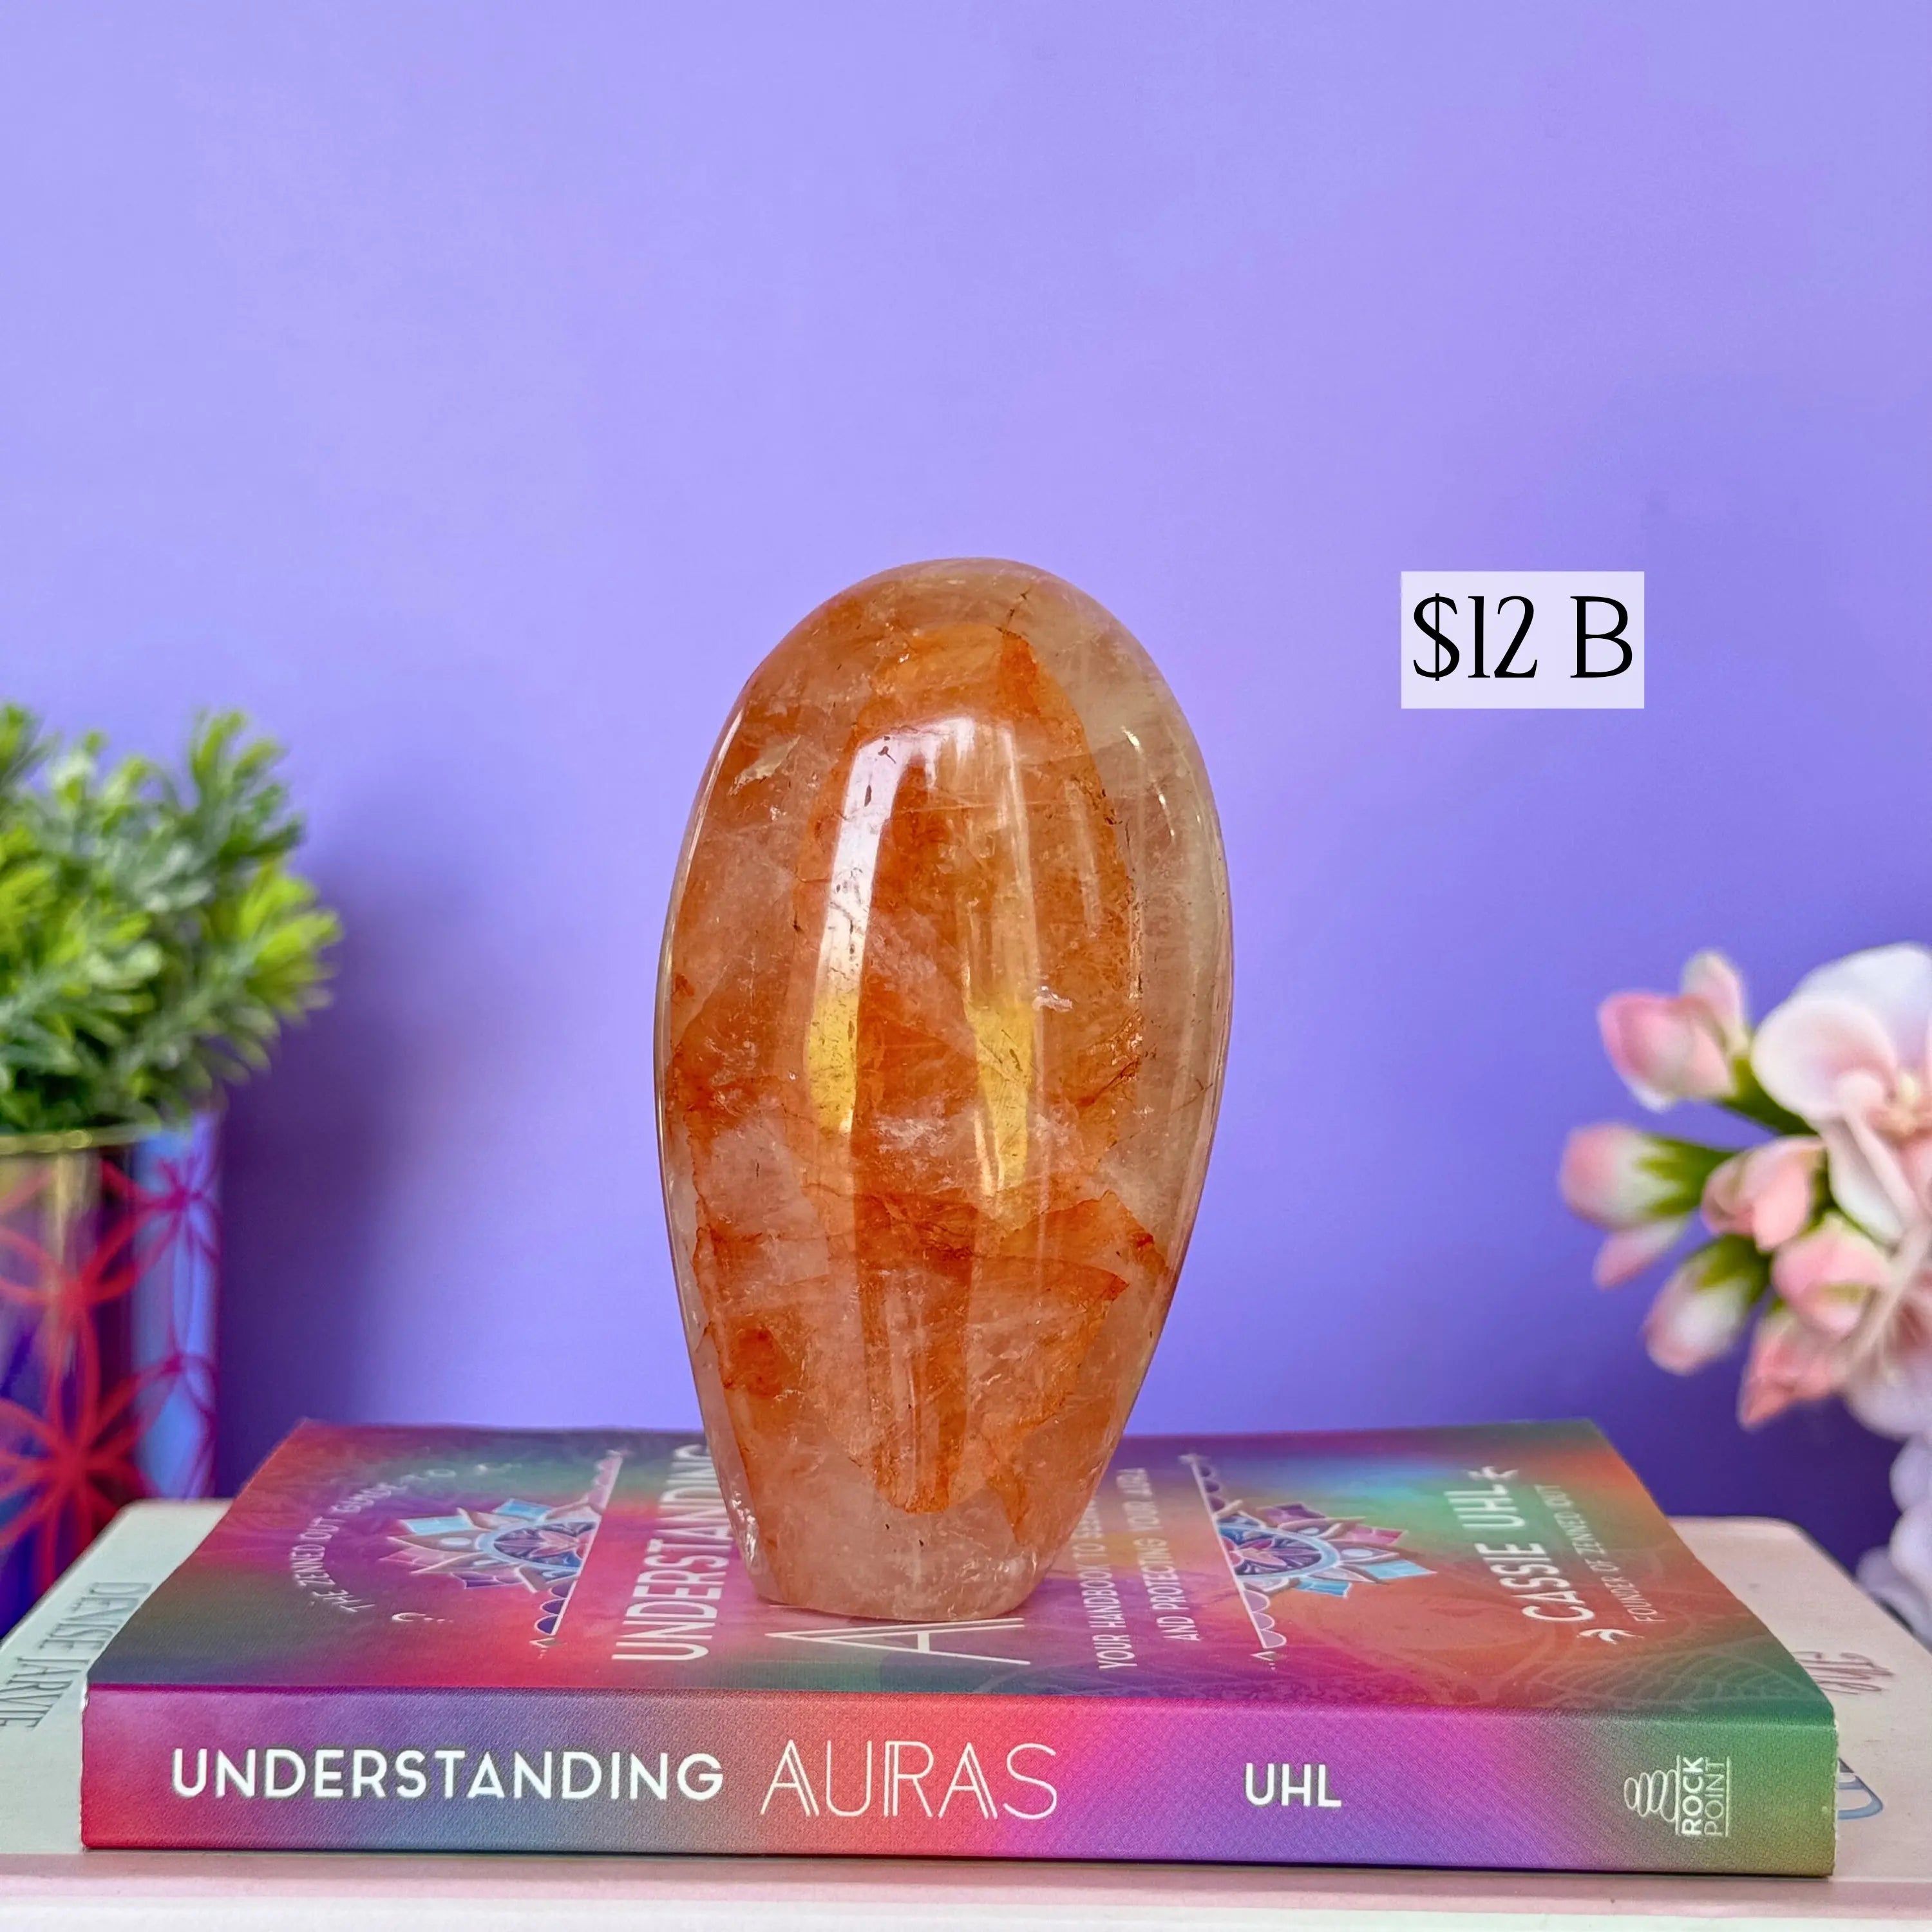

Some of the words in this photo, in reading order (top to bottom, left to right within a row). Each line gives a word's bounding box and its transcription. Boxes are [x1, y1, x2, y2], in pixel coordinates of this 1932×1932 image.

[1123, 1499, 1164, 1532] YOUR
[1443, 1484, 1527, 1531] UHL
[1533, 1484, 1575, 1508] OUT
[298, 1515, 348, 1542] OUT
[1072, 1542, 1108, 1559] TO
[1553, 1513, 1607, 1556] ZENNED
[290, 1544, 336, 1587] ZENNED
[1133, 1537, 1190, 1611] PROTECTING
[1473, 1542, 1596, 1622] CASSIE
[1584, 1558, 1620, 1573] OF
[39, 1582, 153, 1651] DENISE
[312, 1589, 375, 1613] THE
[1074, 1563, 1127, 1629] HANDBOOK
[1600, 1575, 1666, 1622] FOUNDER
[1155, 1615, 1201, 1642] AND
[1092, 1633, 1138, 1670] YOUR
[172, 1748, 723, 1801] UNDERSTANDING
[759, 1739, 1057, 1820] AURAS
[1245, 1762, 1342, 1808] UHL
[1681, 1756, 1704, 1835] ROCK
[1703, 1756, 1725, 1835] POINT
